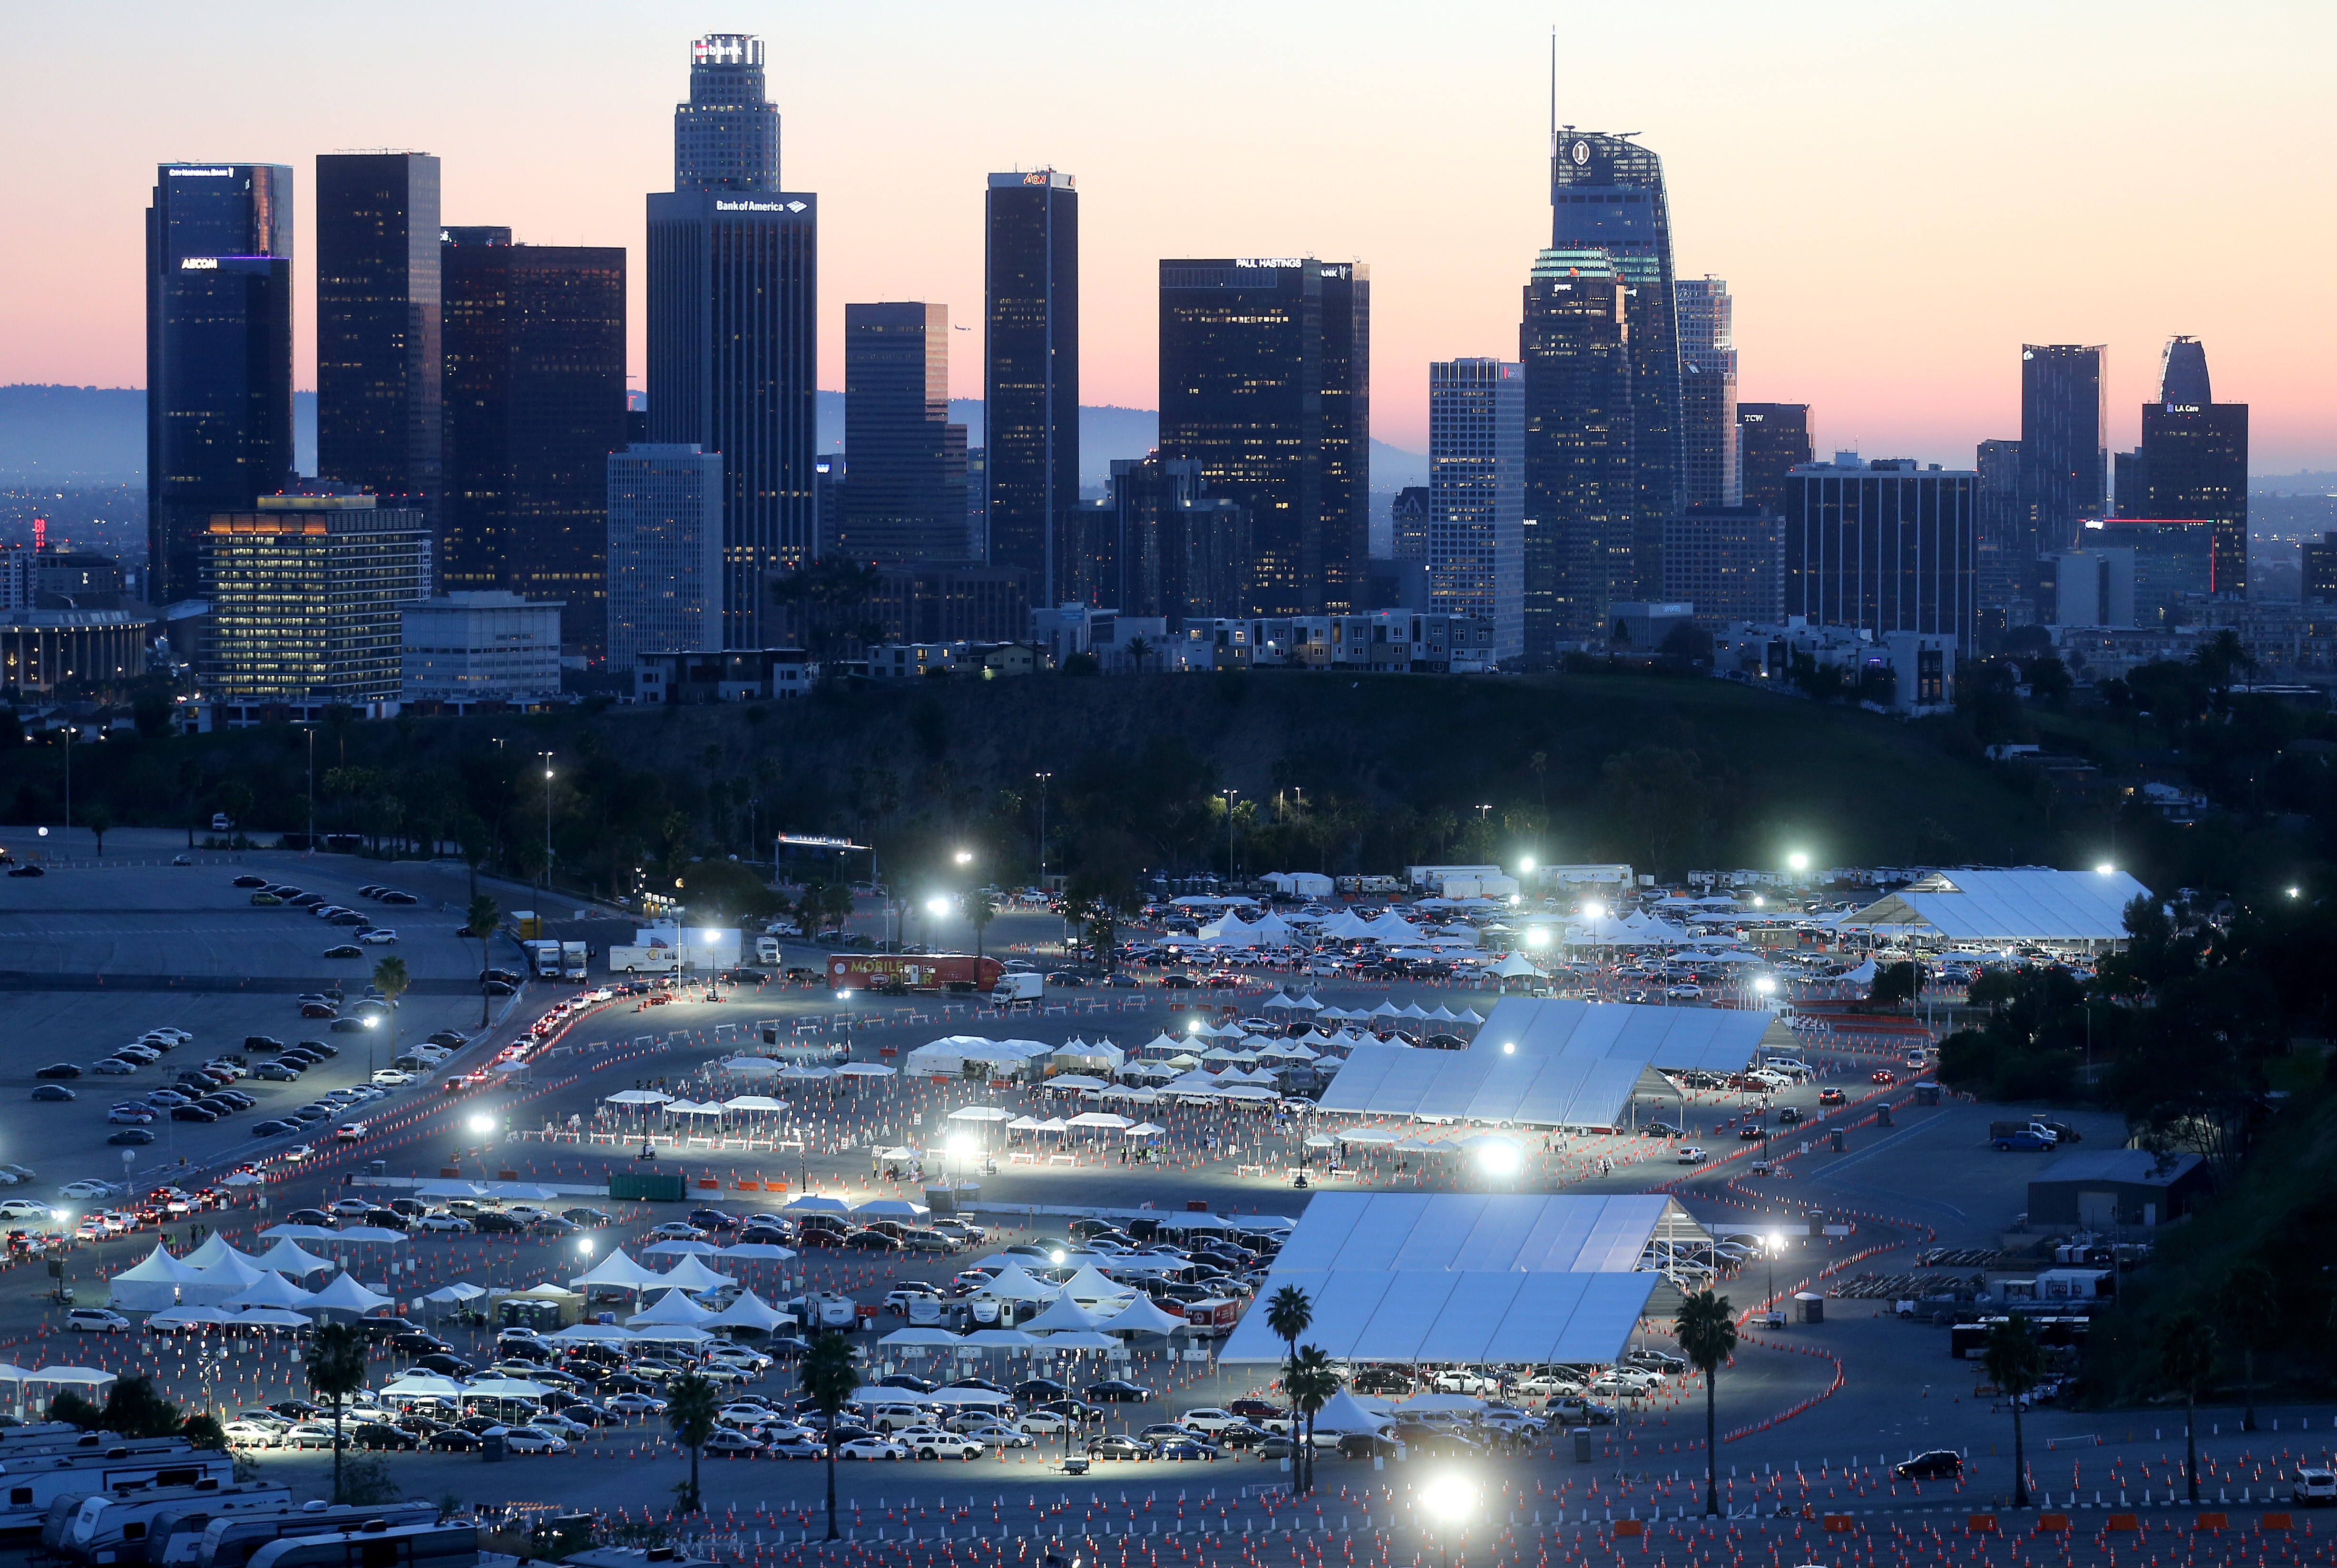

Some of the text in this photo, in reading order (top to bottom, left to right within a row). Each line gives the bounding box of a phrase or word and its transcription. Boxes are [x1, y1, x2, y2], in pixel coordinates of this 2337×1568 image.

[1024, 174, 1047, 185] AON
[716, 200, 784, 212] Bank of America
[181, 258, 218, 269] AECOM
[1236, 259, 1302, 268] PAUL HASTINGS
[1321, 269, 1338, 277] ANK
[1554, 284, 1572, 292] pwc
[851, 961, 904, 972] MOBILE
